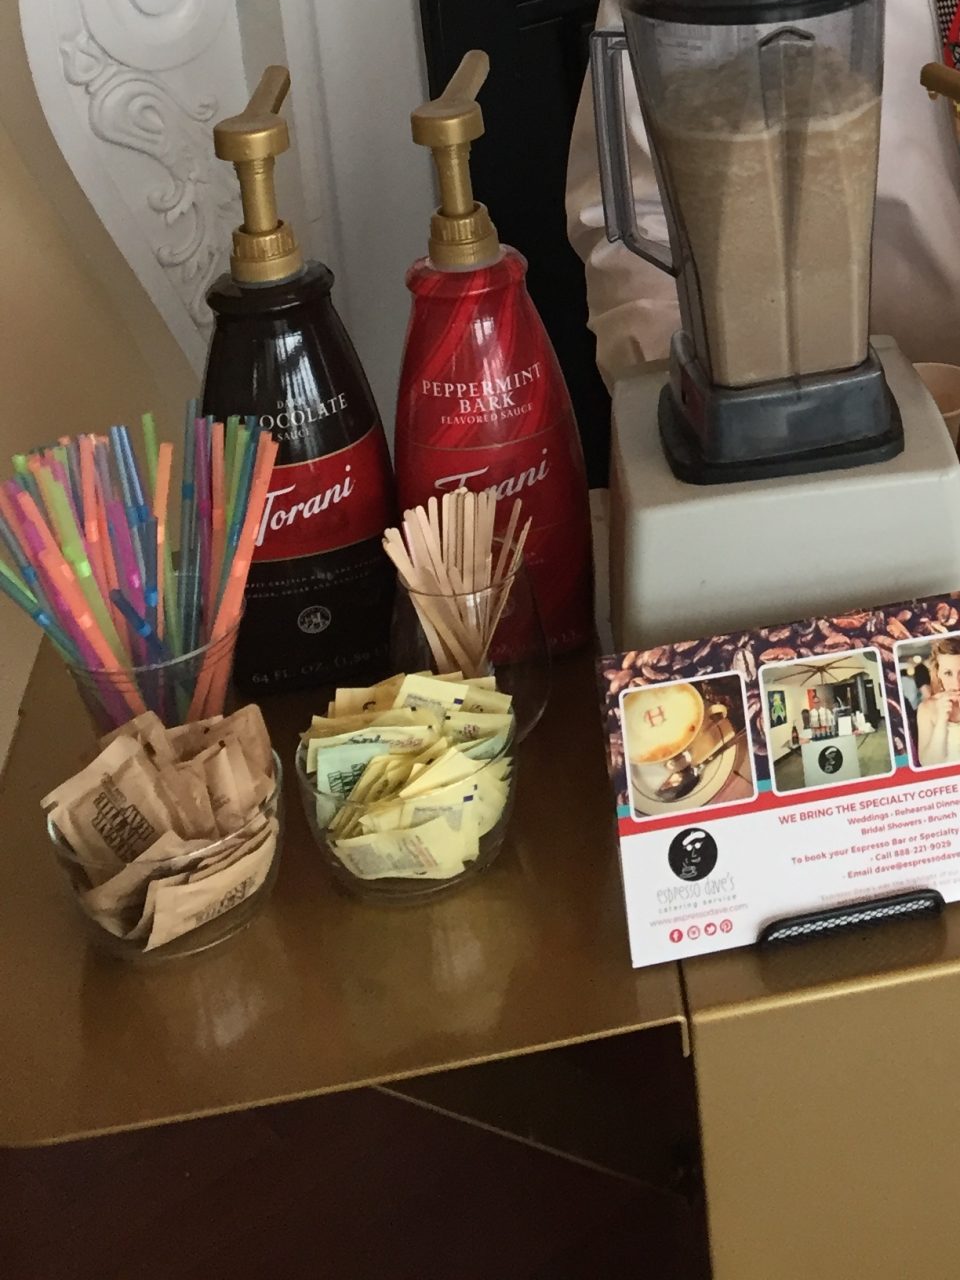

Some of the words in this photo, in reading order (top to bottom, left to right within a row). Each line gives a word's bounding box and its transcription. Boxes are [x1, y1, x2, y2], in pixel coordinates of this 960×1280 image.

[422, 362, 542, 397] PEPPERMINT
[441, 413, 498, 426] FLAVORED
[500, 402, 535, 420] SAUCE
[460, 391, 516, 415] BARK
[254, 464, 356, 547] Torani
[778, 813, 797, 825] WE
[799, 807, 834, 821] BRING
[835, 802, 857, 815] THE
[859, 792, 916, 811] SPECIALTY
[918, 783, 959, 799] COFFEE
[847, 812, 889, 825] Weddings
[894, 803, 935, 816] Rehearsal
[861, 825, 886, 836] Bridal
[887, 818, 922, 830] Showers
[928, 811, 957, 822] Brunch
[792, 856, 803, 865] To
[805, 851, 826, 862] book
[829, 848, 848, 859] your
[851, 840, 889, 854] Espresso
[891, 837, 906, 845] Bar
[920, 827, 959, 841] Specialty
[875, 849, 892, 861] Call
[848, 867, 872, 879] Email
[657, 881, 701, 904] espresso
[704, 872, 735, 897] dave's
[659, 901, 698, 914] catering
[702, 894, 737, 906] service
